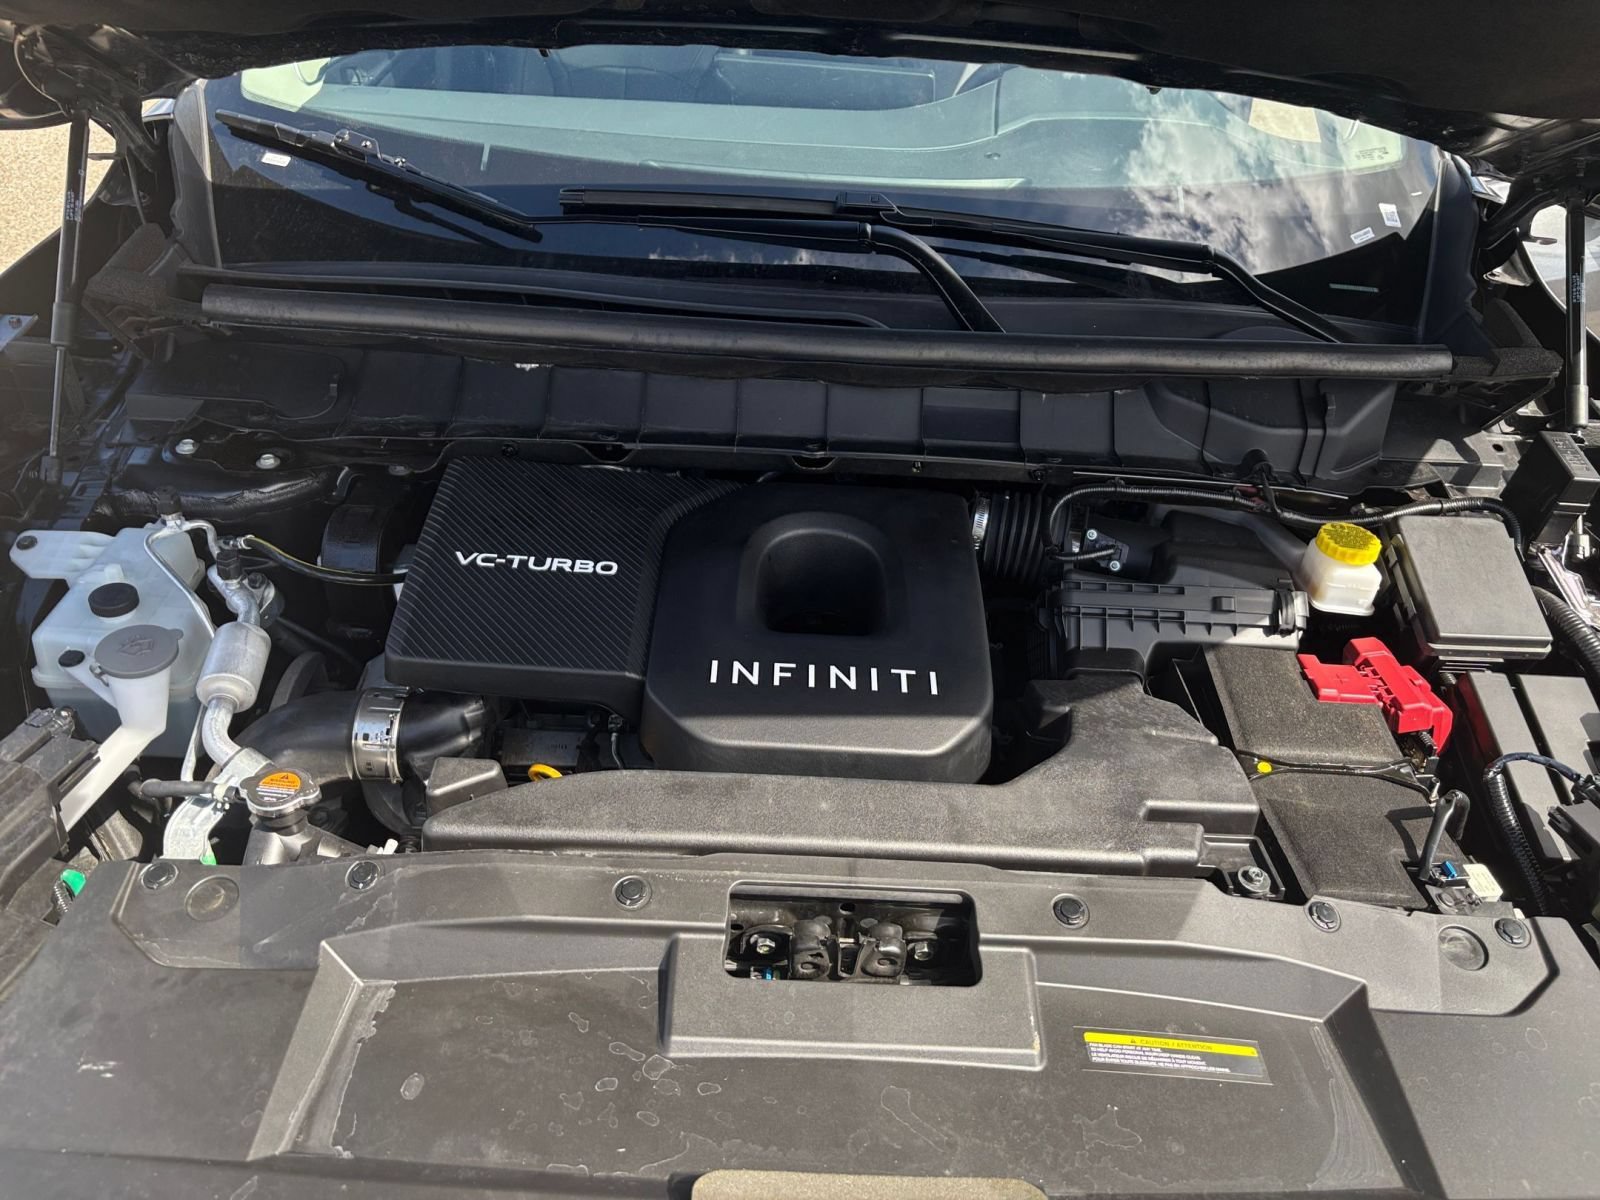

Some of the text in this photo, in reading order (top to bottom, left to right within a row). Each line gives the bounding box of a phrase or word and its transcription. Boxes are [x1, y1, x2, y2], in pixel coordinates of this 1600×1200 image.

[455, 551, 618, 576] VC-TURBO
[709, 659, 938, 695] INFINITI
[1140, 1039, 1169, 1048] CAUTION
[1176, 1042, 1213, 1051] ATTENTION
